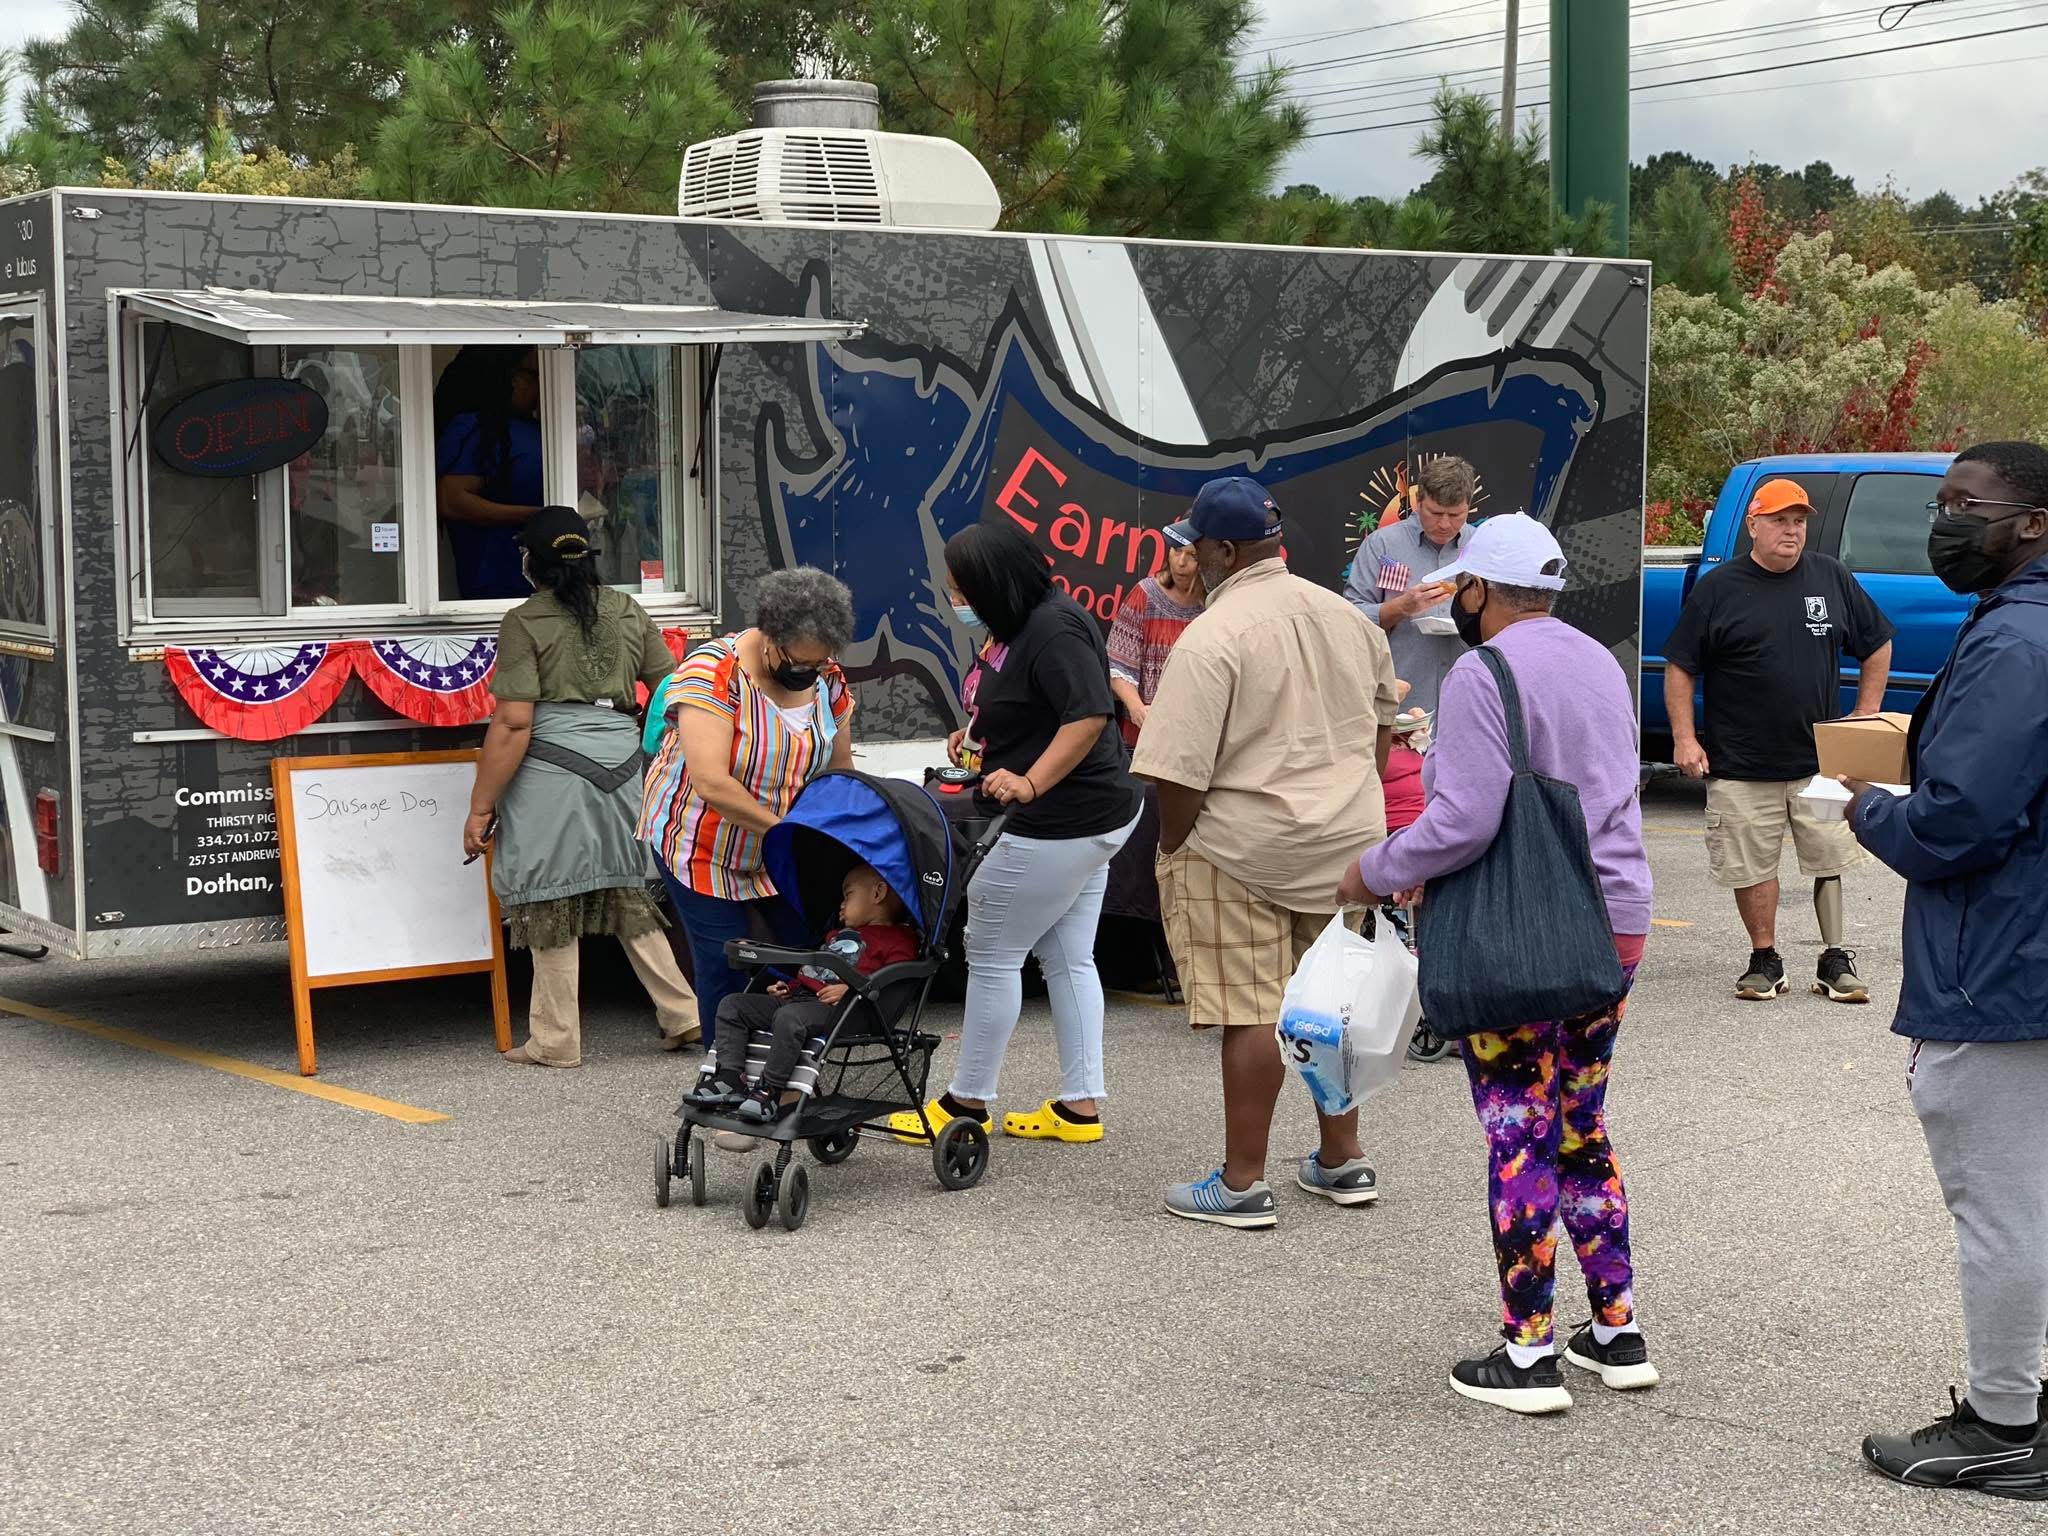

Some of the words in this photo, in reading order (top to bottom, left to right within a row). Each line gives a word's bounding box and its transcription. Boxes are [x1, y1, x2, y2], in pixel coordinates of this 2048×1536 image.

[175, 393, 311, 461] OPEN
[305, 783, 391, 821] Sausage
[400, 791, 438, 816] Dog
[206, 814, 255, 828] THIRSTY
[257, 812, 276, 824] PIG
[188, 854, 207, 866] 257
[209, 853, 216, 865] S
[217, 852, 230, 863] ST
[231, 848, 281, 862] ANDREWS
[186, 872, 274, 896] Dothan,
